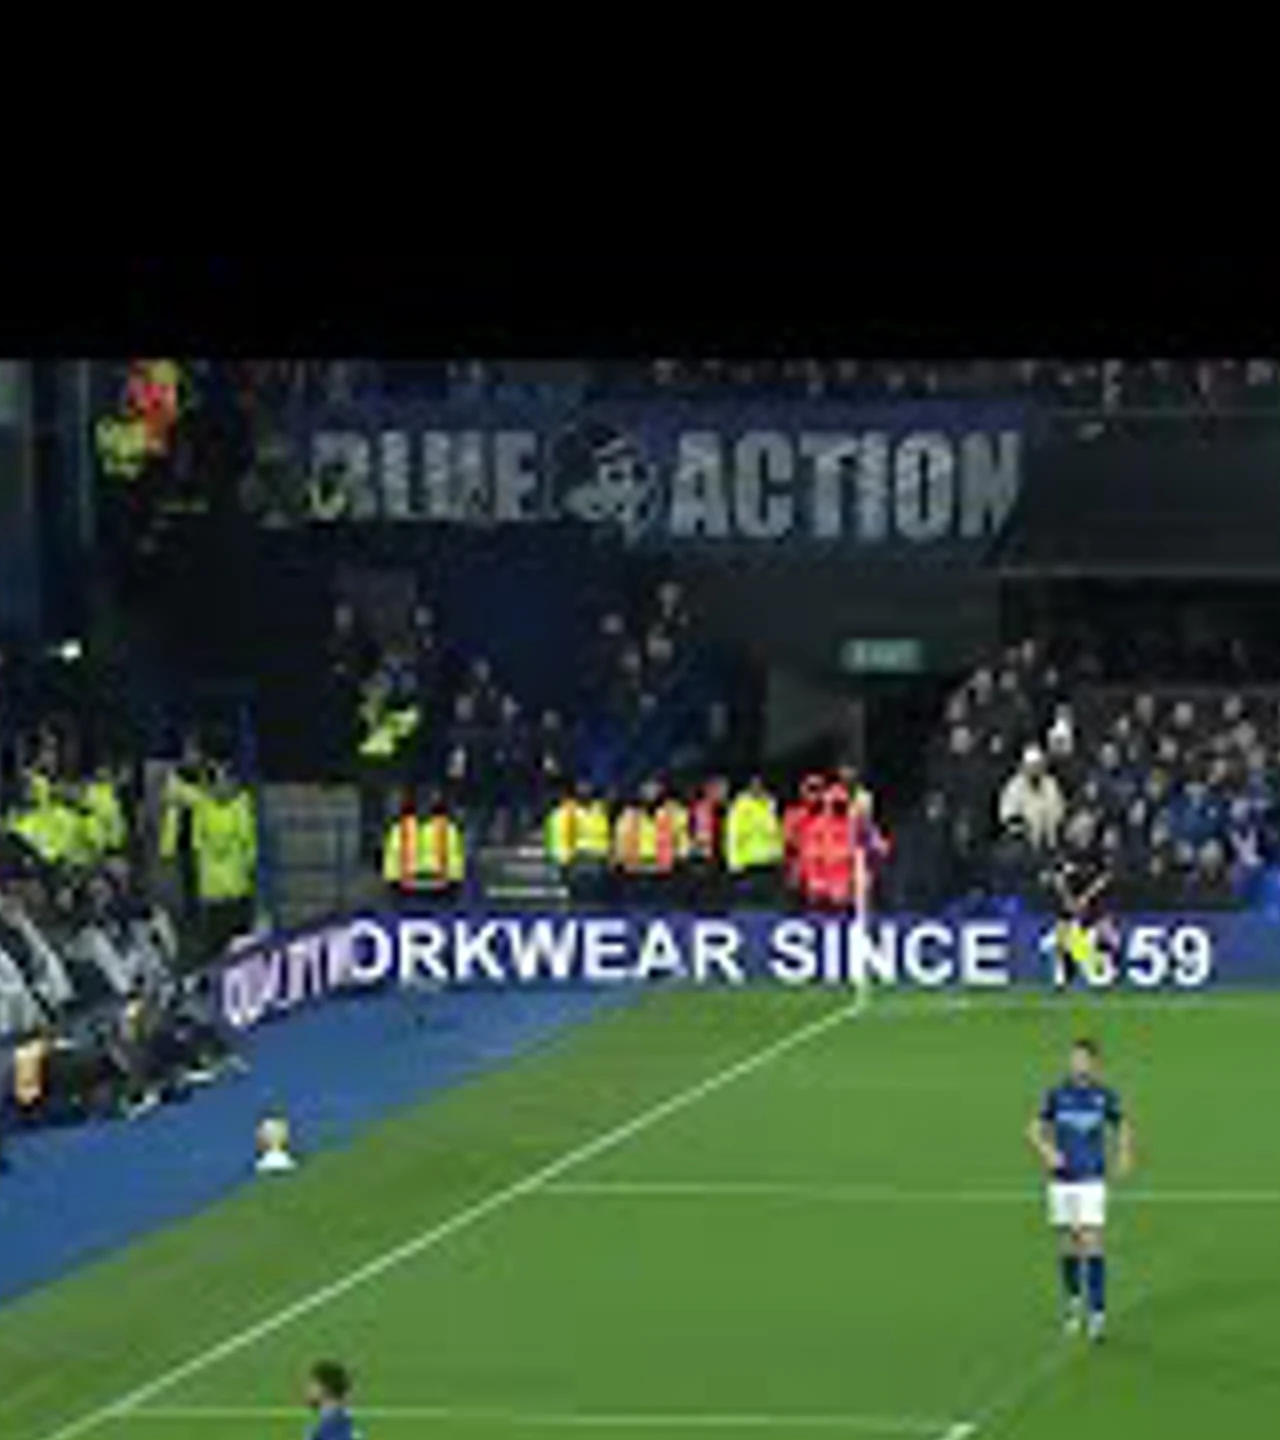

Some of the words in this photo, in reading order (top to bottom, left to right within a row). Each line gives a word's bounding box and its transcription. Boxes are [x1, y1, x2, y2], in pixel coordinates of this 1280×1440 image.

[312, 430, 538, 522] BLUE
[668, 430, 1022, 540] ACTION
[769, 920, 1010, 984] SINCE
